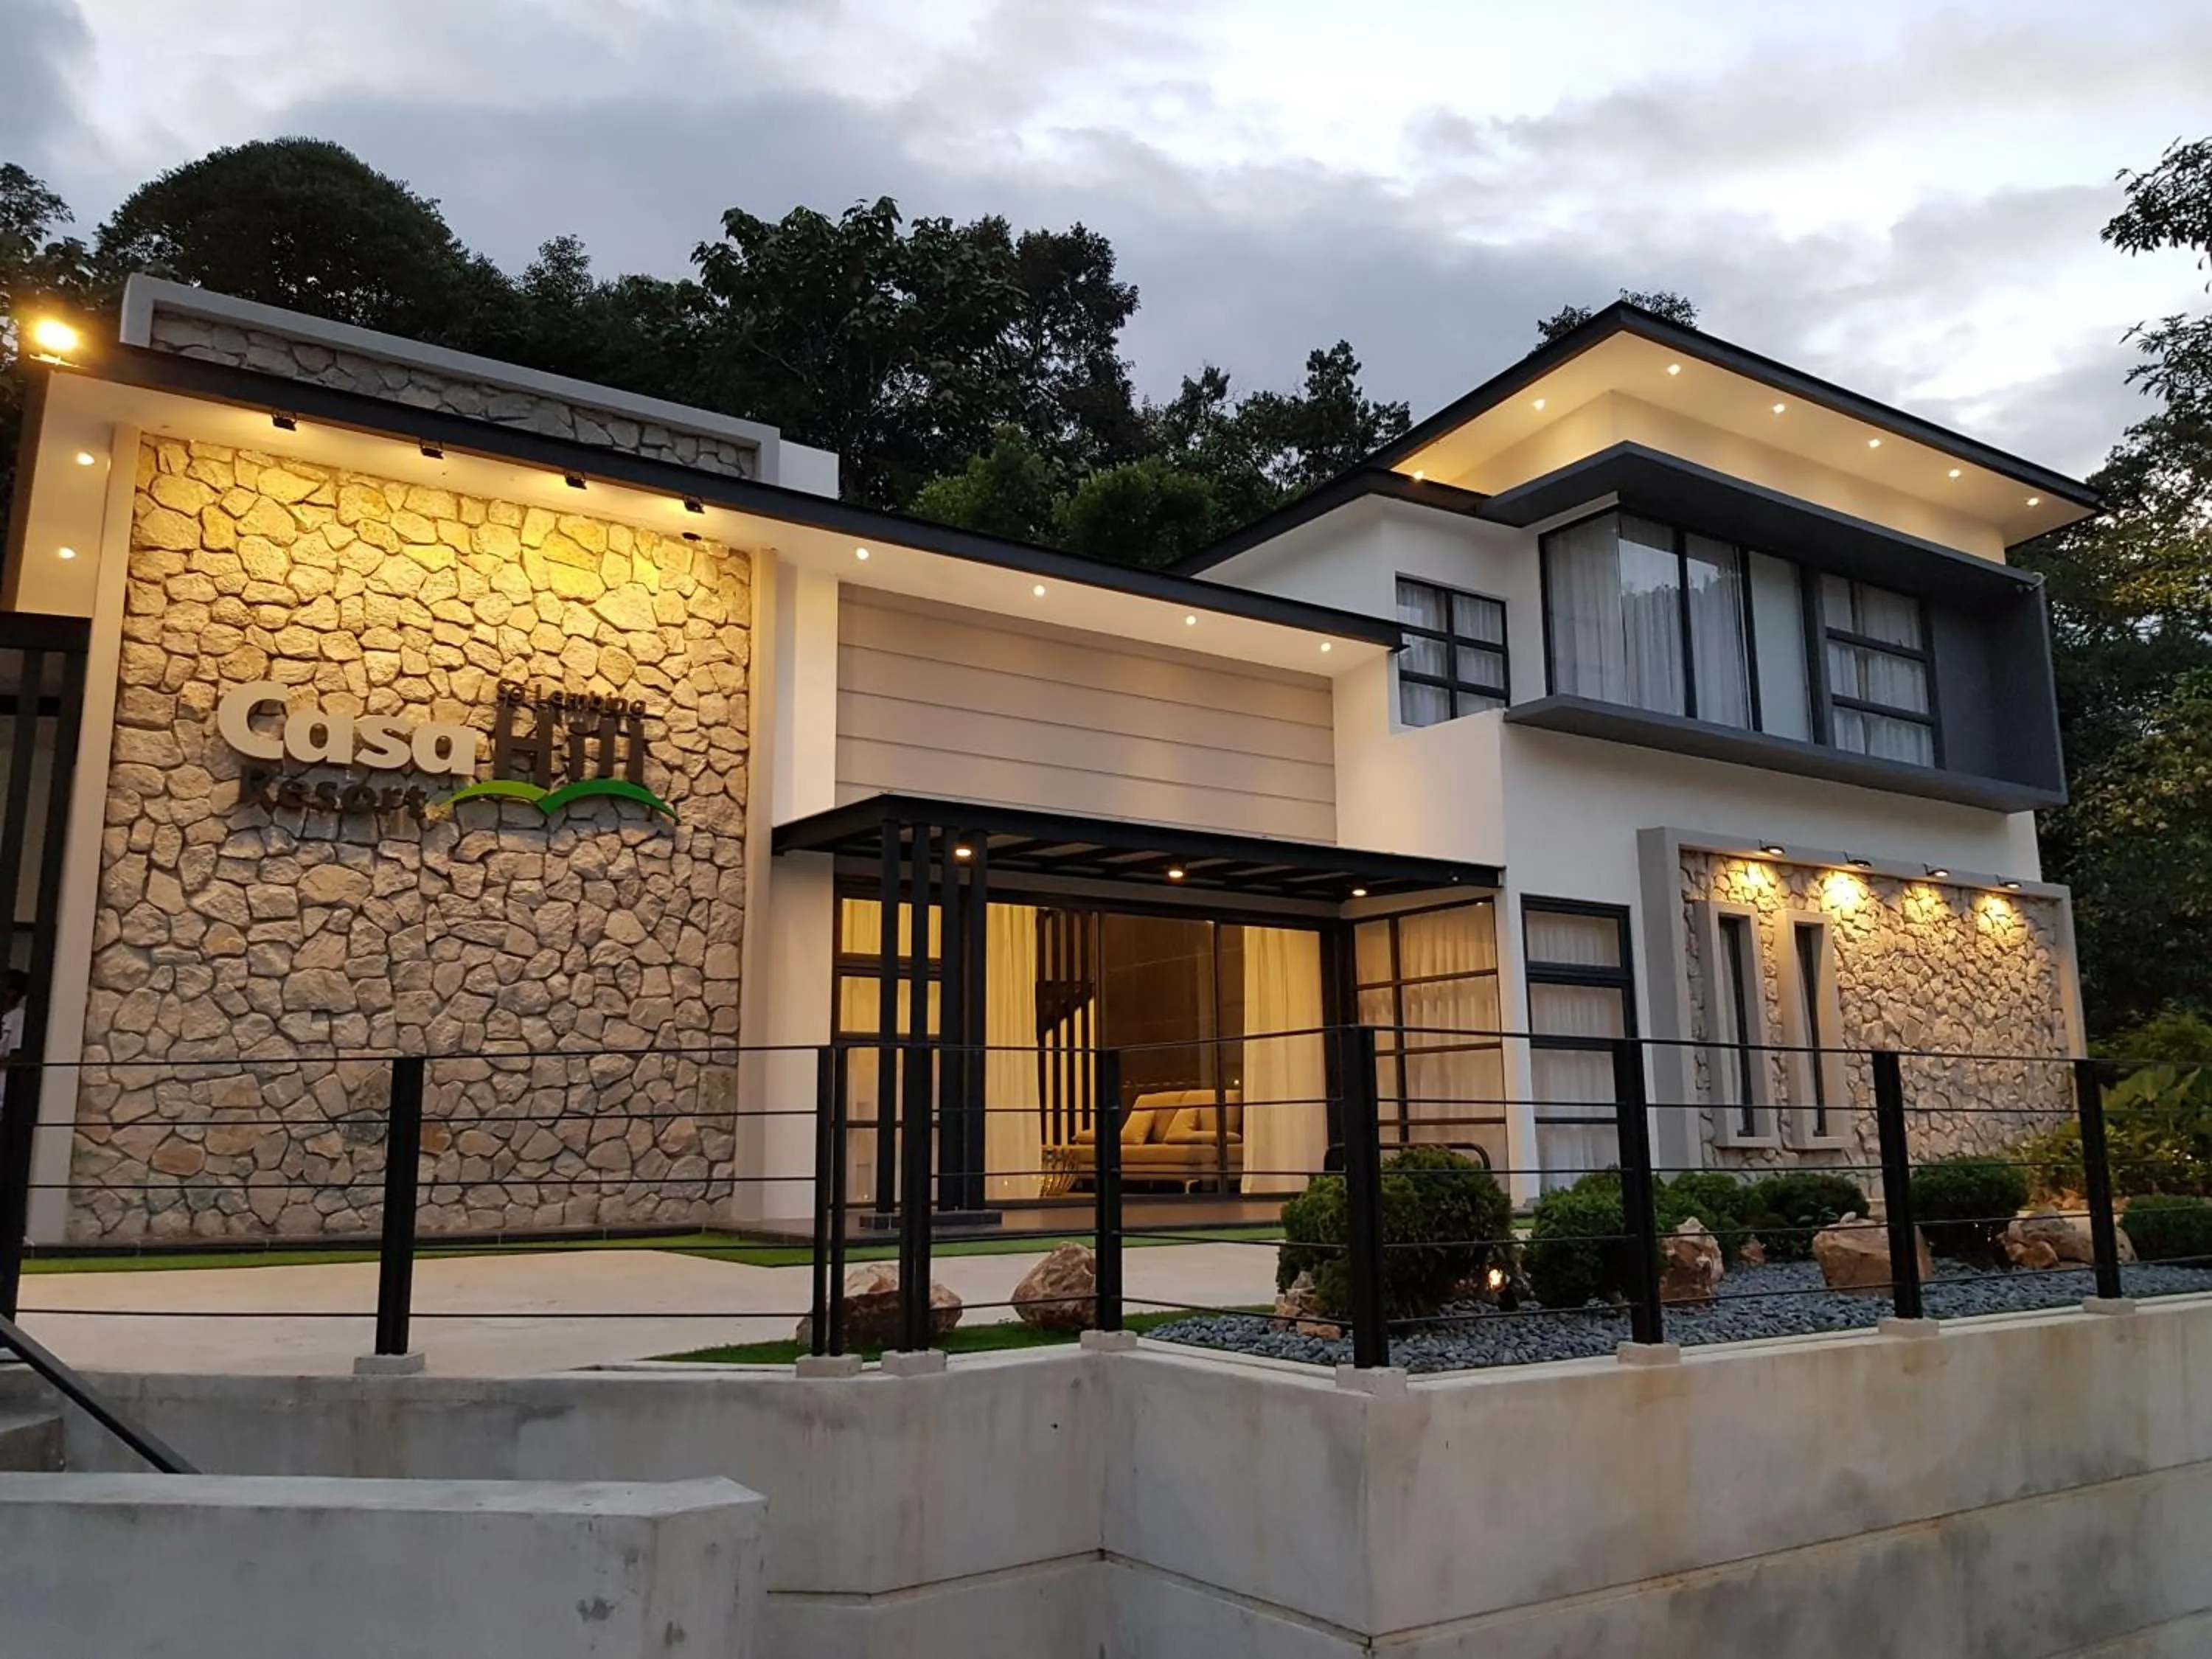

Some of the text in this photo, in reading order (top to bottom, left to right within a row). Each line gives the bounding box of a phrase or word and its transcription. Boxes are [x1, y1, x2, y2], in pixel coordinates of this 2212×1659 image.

[535, 684, 647, 719] Lembing
[218, 681, 645, 790] Casa Hill
[240, 764, 428, 821] Resort
